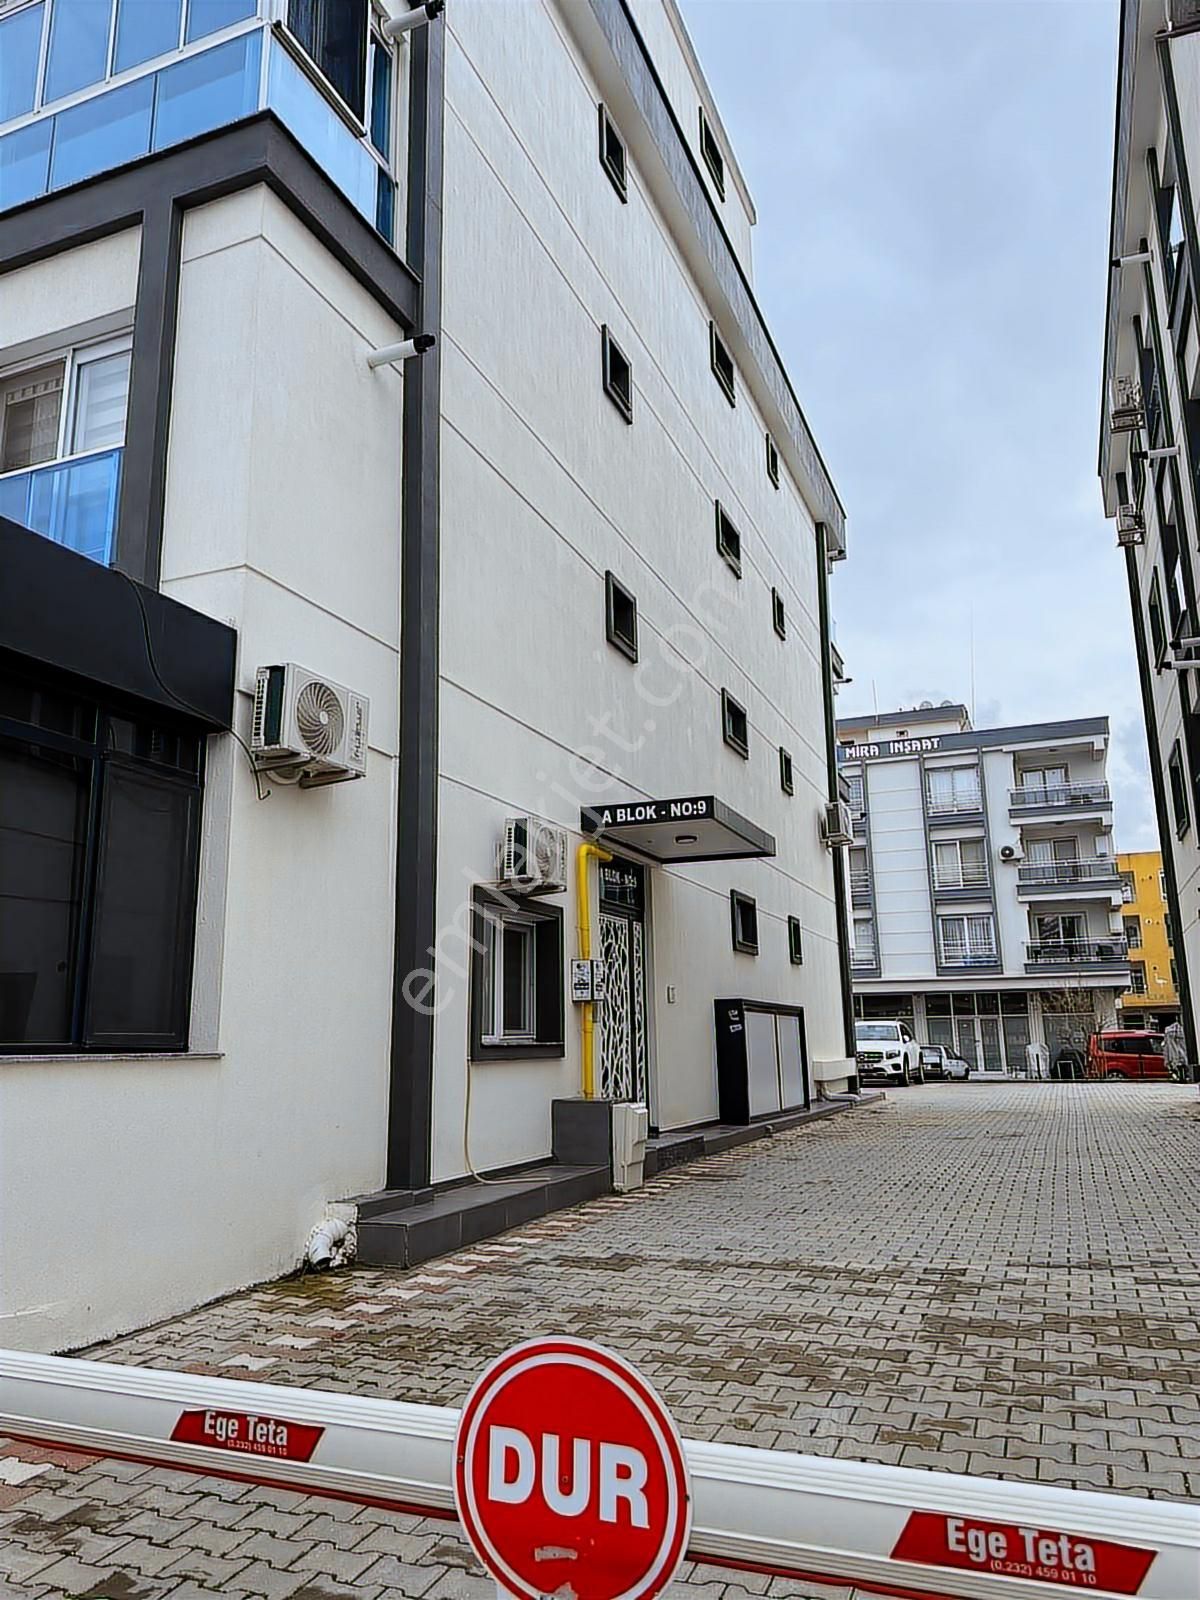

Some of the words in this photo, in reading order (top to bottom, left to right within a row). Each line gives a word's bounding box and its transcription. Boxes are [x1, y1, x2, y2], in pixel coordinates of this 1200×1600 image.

[602, 810, 612, 824] A
[616, 804, 657, 822] BLOK
[670, 800, 707, 817] NO:9
[204, 1410, 239, 1442] Ege
[246, 1415, 288, 1446] Teta
[488, 1424, 650, 1530] DUR
[946, 1517, 1007, 1563] Ege
[1018, 1527, 1096, 1573] Teta
[990, 1560, 1033, 1577] (0.232)
[1035, 1567, 1059, 1580] 459
[1062, 1570, 1076, 1583] 01
[1081, 1573, 1096, 1585] 10
